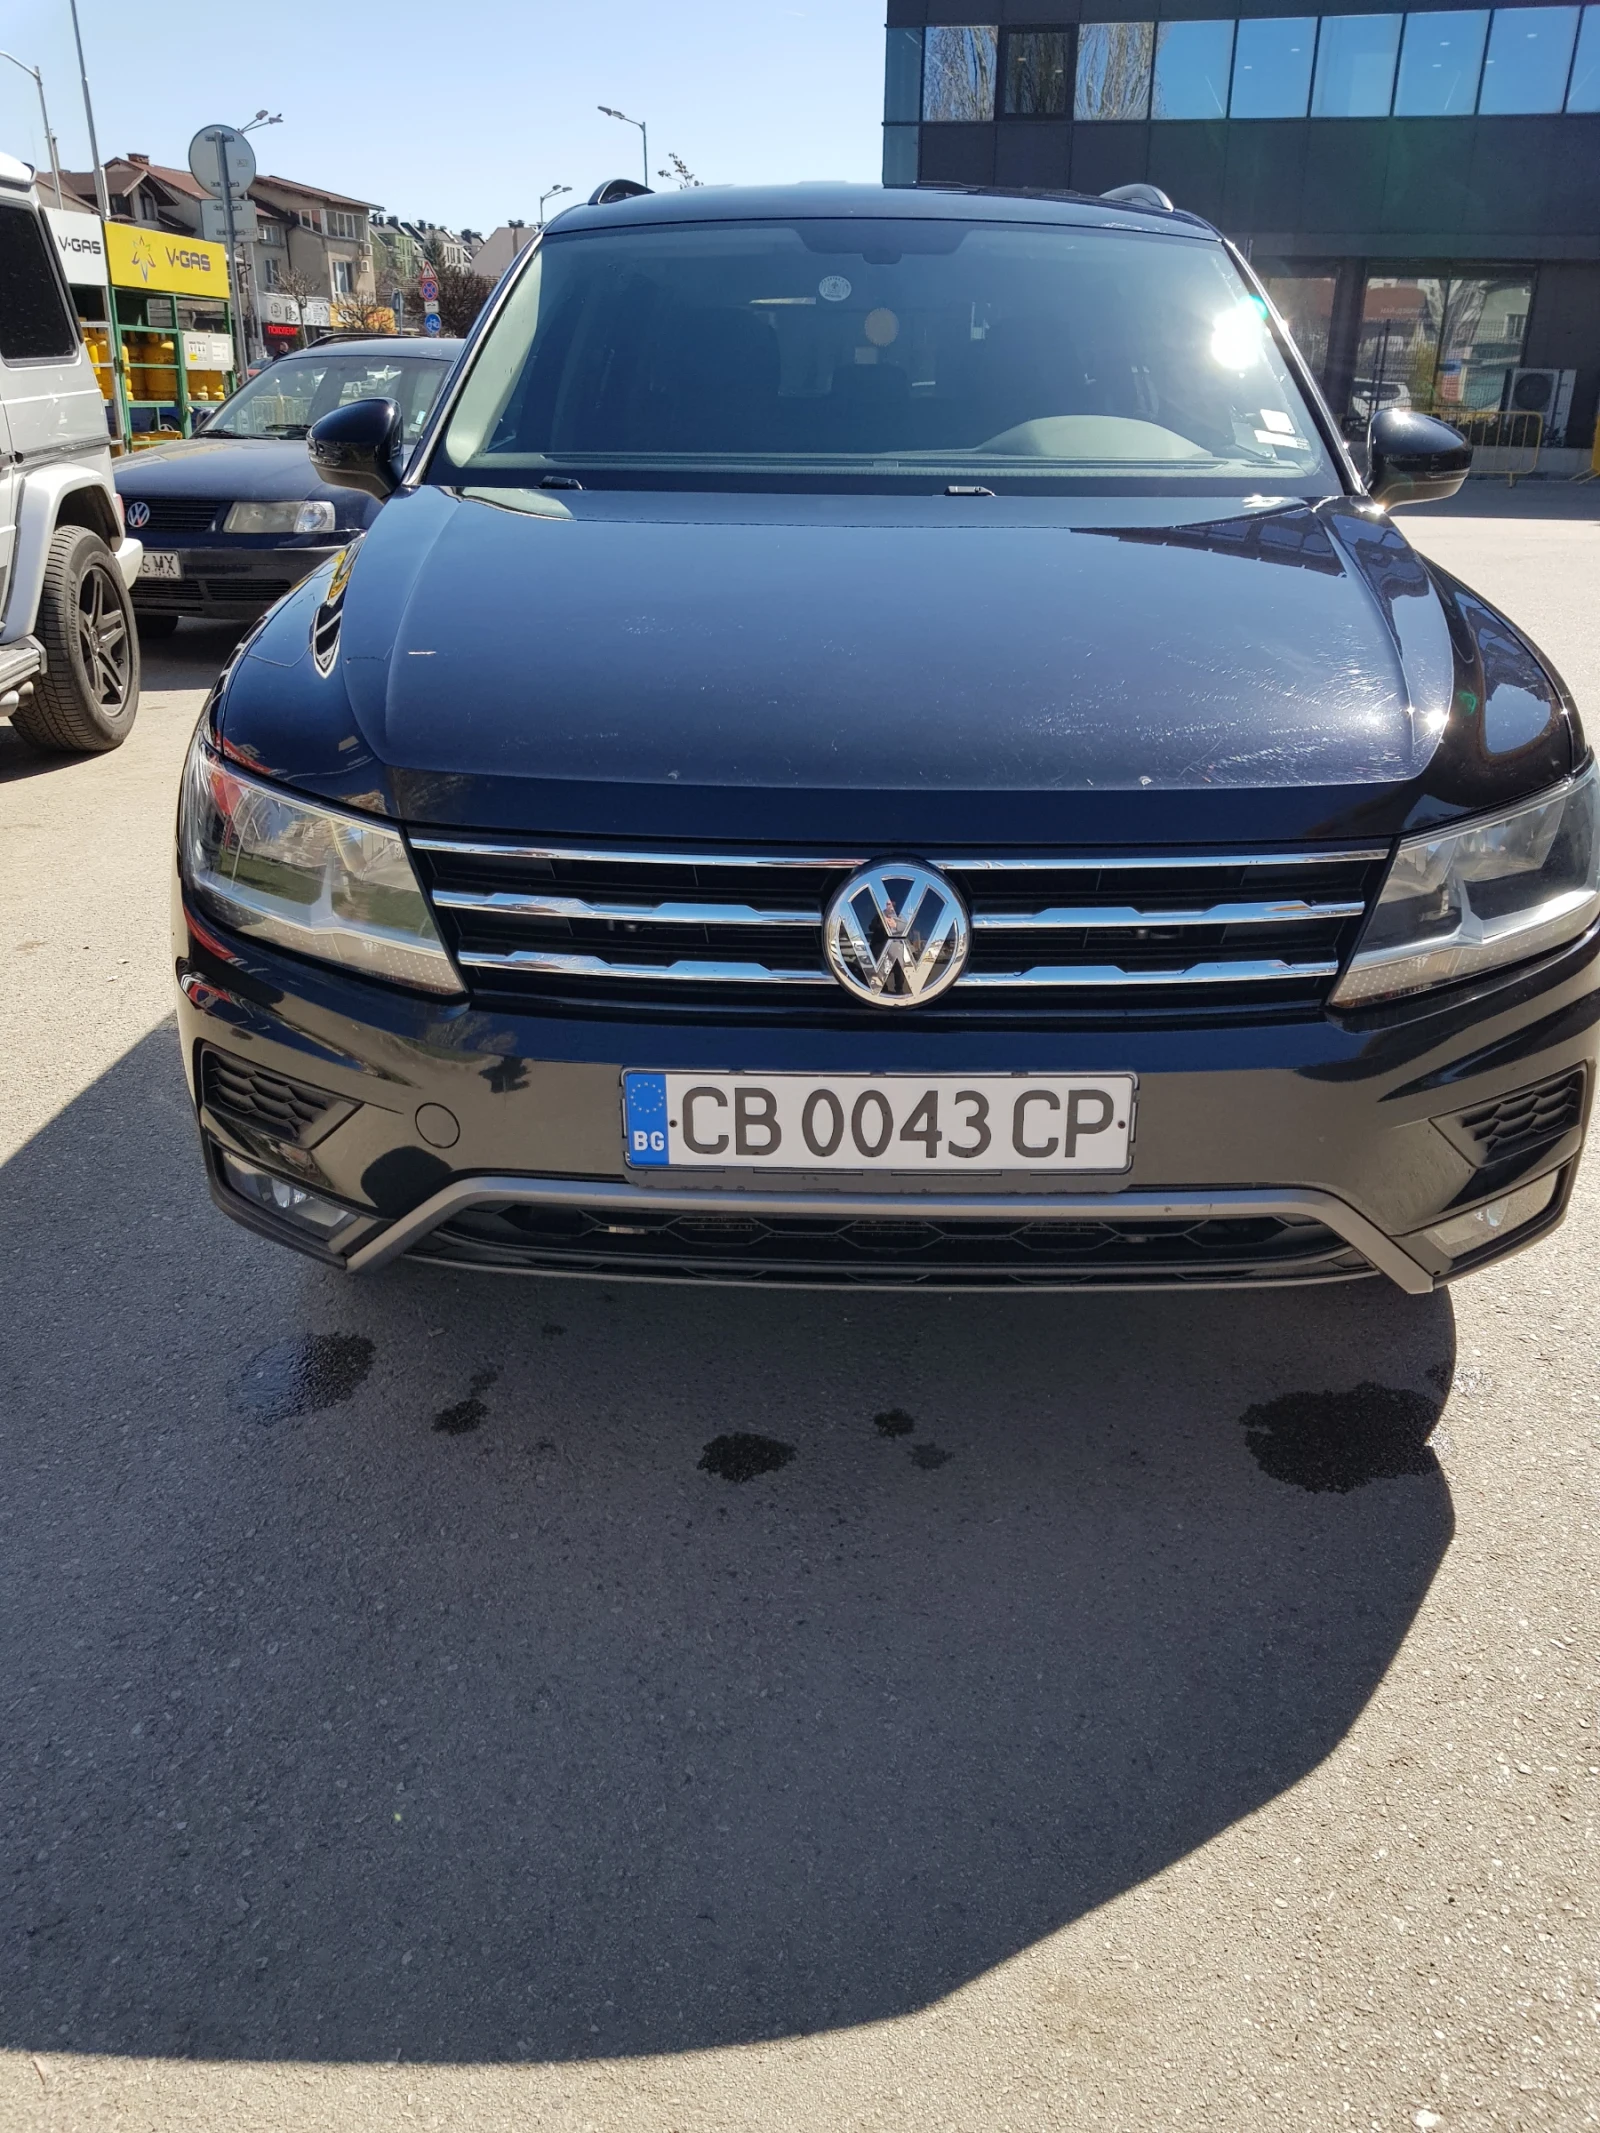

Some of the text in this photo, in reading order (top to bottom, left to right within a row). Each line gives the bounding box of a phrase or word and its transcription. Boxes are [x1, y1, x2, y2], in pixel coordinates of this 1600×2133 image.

[633, 1086, 1115, 1159] BG CB 0043 CP
